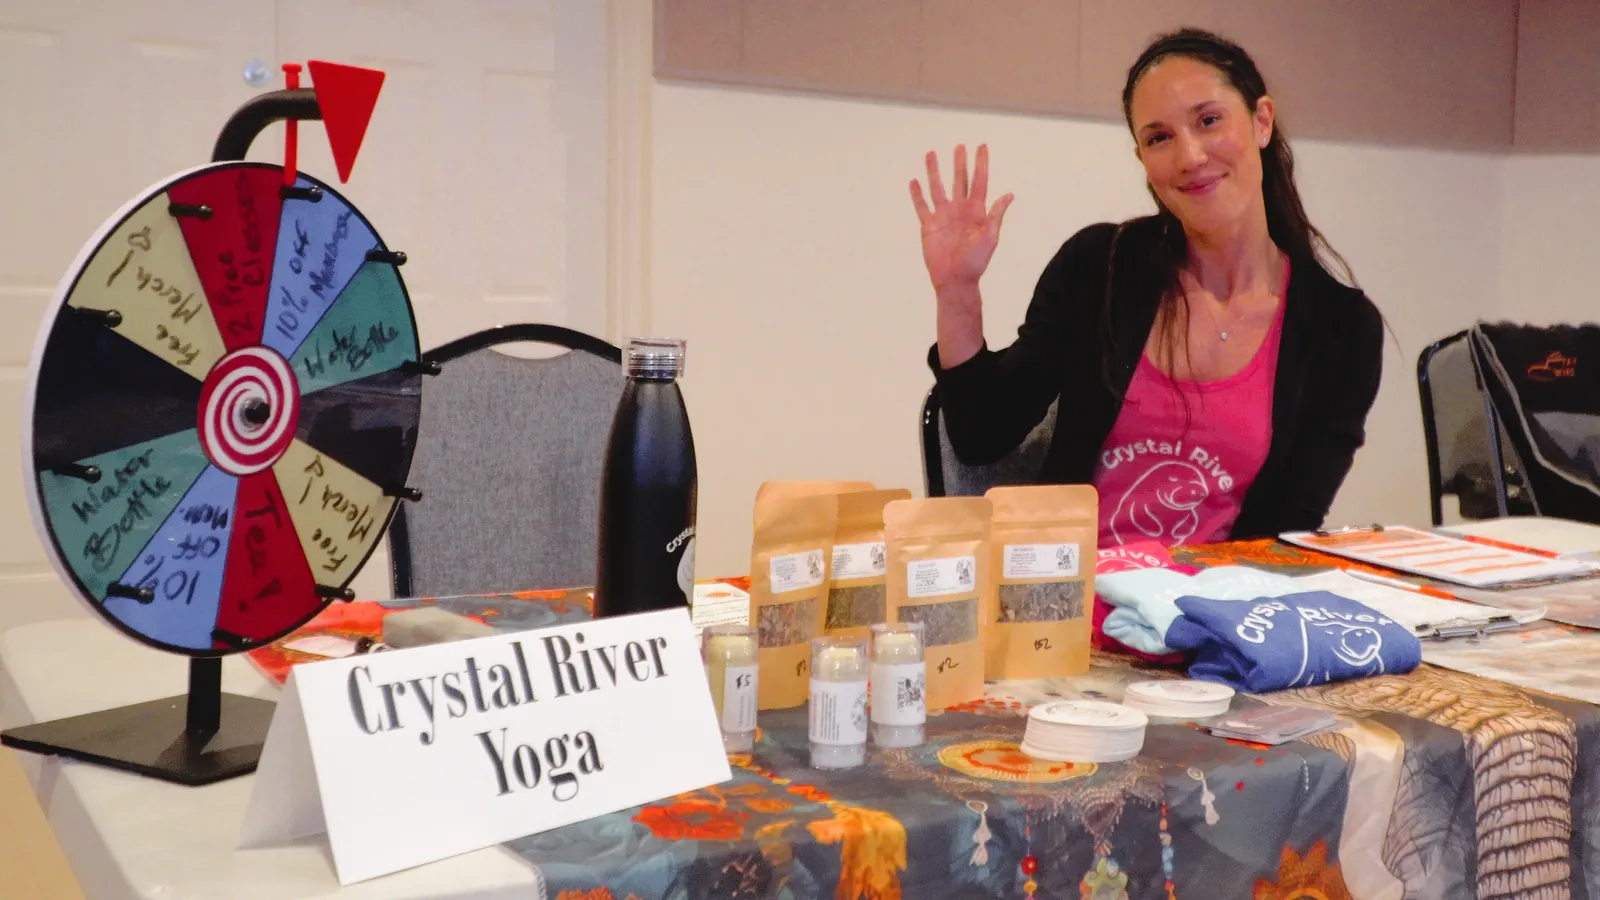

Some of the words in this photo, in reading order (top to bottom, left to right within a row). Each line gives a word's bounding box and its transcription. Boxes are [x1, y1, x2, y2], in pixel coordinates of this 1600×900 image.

[226, 312, 254, 337] 2
[276, 286, 309, 341] 10%
[156, 323, 200, 366] Free
[1102, 439, 1182, 470] Crystal
[83, 475, 172, 572] Bottle
[311, 528, 348, 573] Free
[134, 554, 200, 604] 10%
[1296, 606, 1393, 627] River
[346, 641, 538, 746] Crystal
[541, 631, 670, 698] River
[475, 727, 605, 802] Yoga
